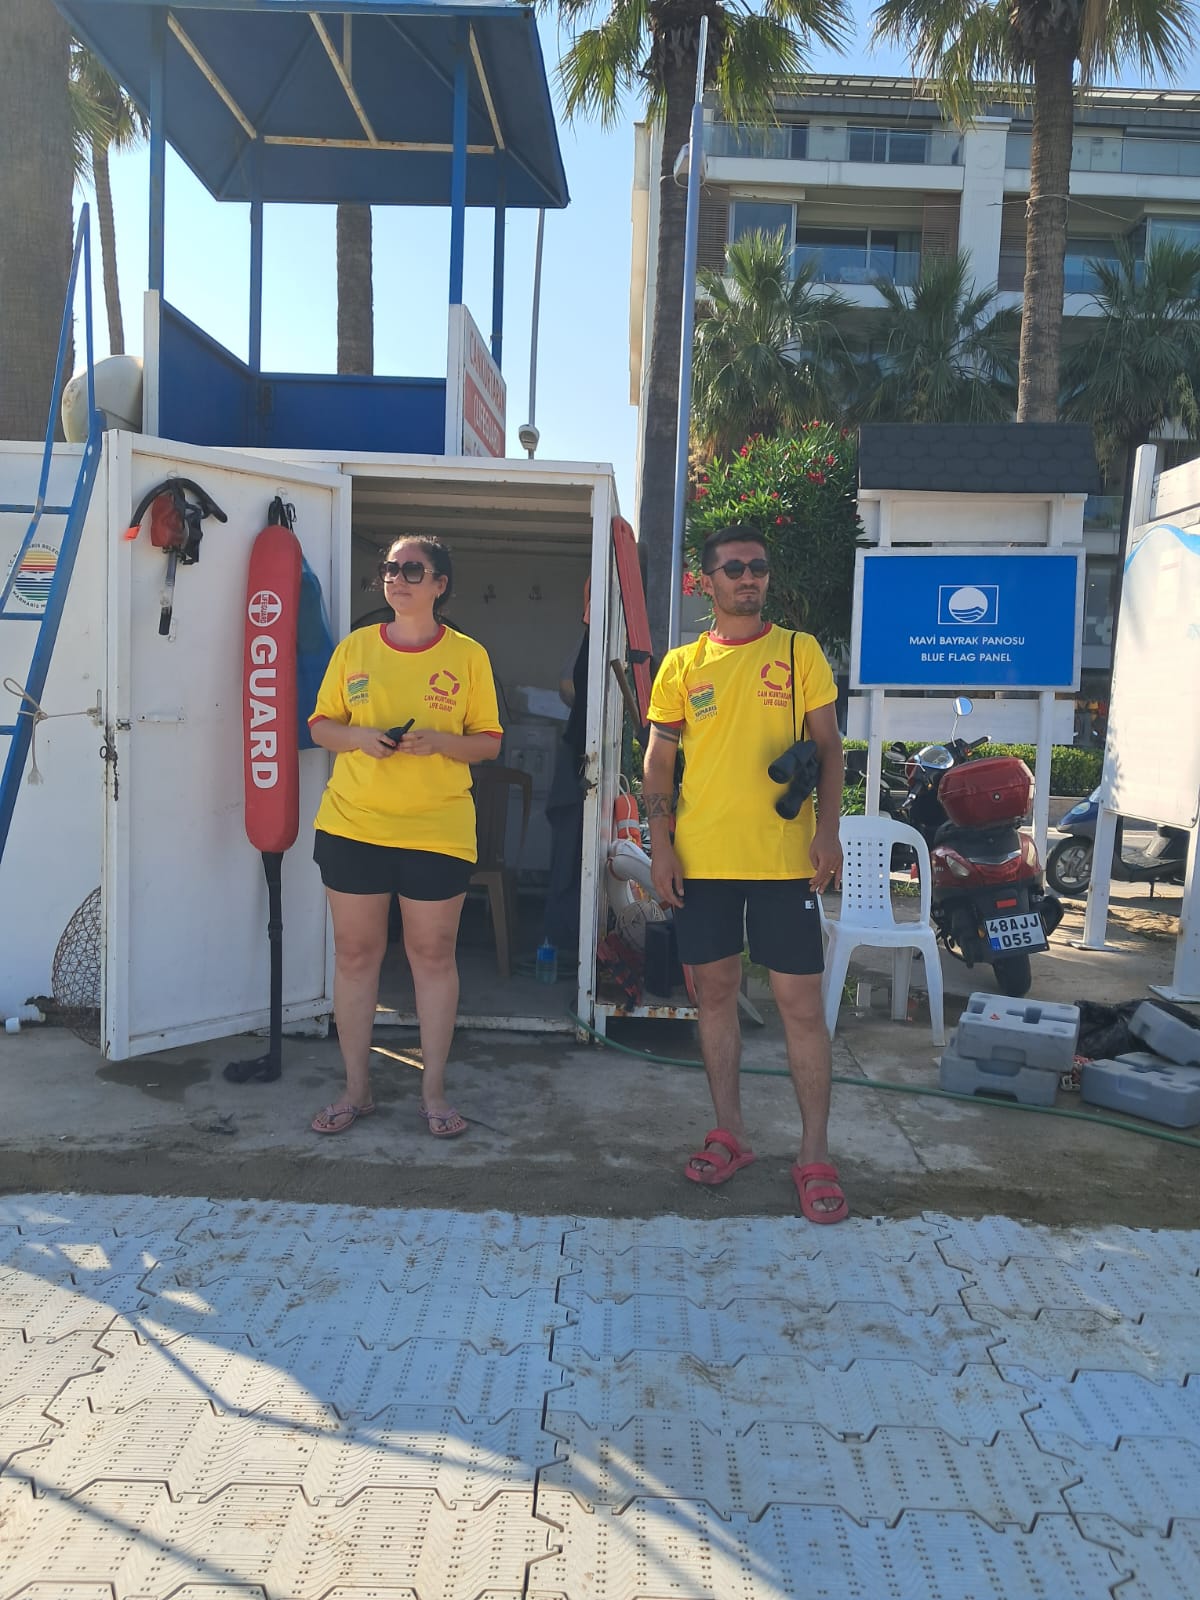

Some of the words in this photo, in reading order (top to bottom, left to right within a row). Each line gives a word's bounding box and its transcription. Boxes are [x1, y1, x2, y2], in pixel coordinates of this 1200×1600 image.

[909, 634, 936, 645] MAVİ
[939, 636, 979, 645] BAYRAK
[982, 636, 1025, 646] PANOSU
[921, 653, 945, 662] BLUE
[948, 653, 976, 662] FLAG
[979, 653, 1012, 662] PANEL
[249, 634, 279, 789] GUARD
[989, 914, 1039, 934] 48AJJ
[1002, 932, 1032, 947] 055
